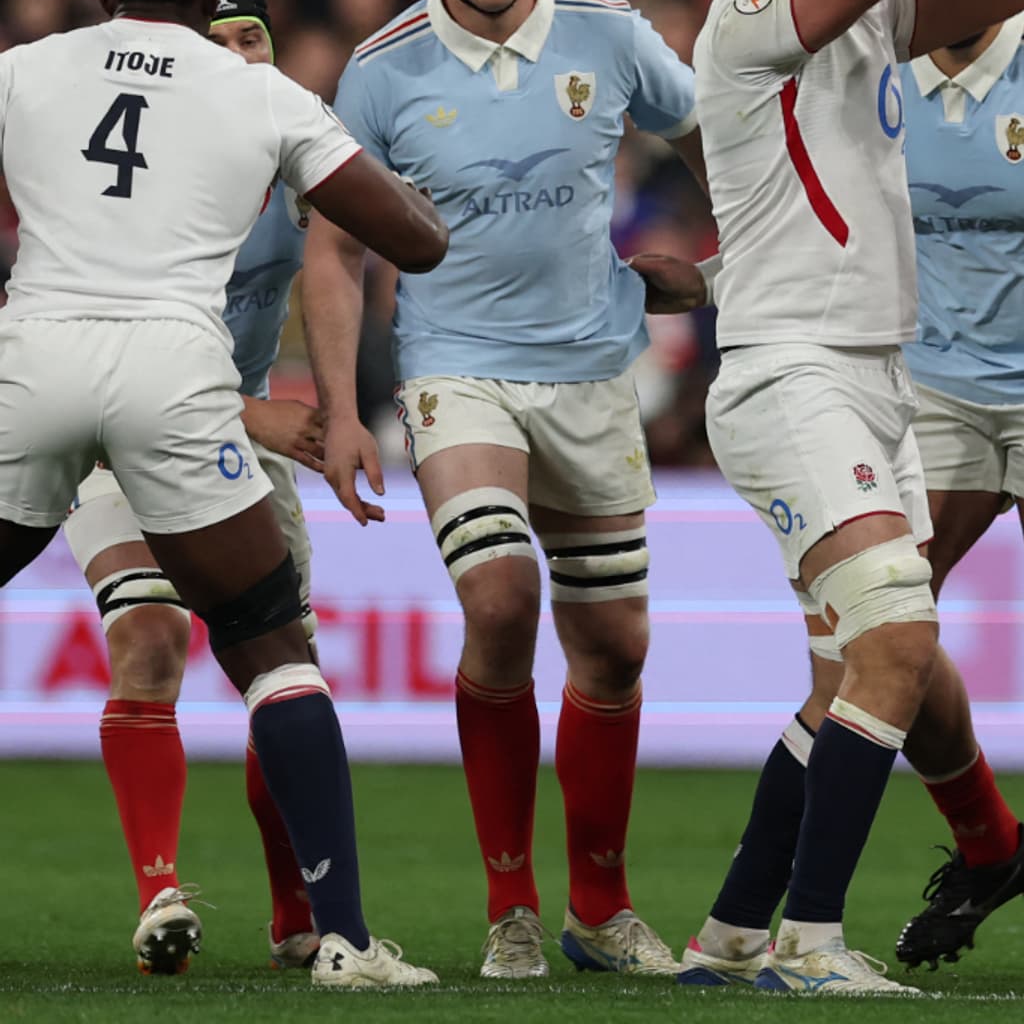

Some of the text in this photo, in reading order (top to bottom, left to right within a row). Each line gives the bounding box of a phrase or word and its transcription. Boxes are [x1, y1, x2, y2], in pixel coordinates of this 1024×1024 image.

[104, 50, 175, 78] ITOJE
[878, 63, 906, 155] O
[80, 92, 150, 199] 4
[461, 184, 575, 217] ALTRAD
[229, 286, 279, 314] RAD
[769, 498, 807, 536] O2
